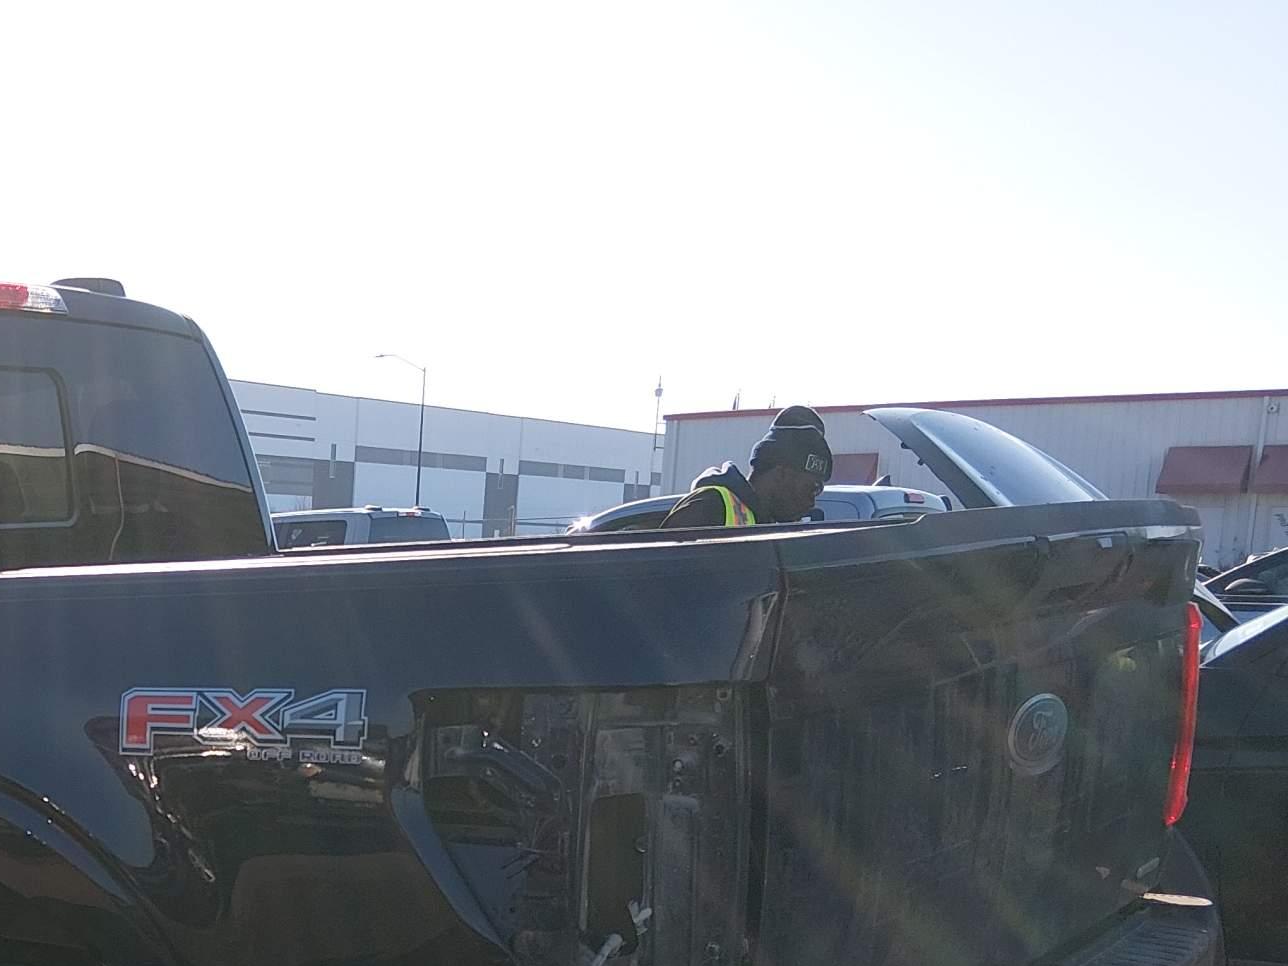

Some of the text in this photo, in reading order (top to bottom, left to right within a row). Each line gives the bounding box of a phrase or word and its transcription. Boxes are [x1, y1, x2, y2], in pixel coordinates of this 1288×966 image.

[119, 687, 368, 756] FX4
[246, 749, 362, 765] OFF ROAD
